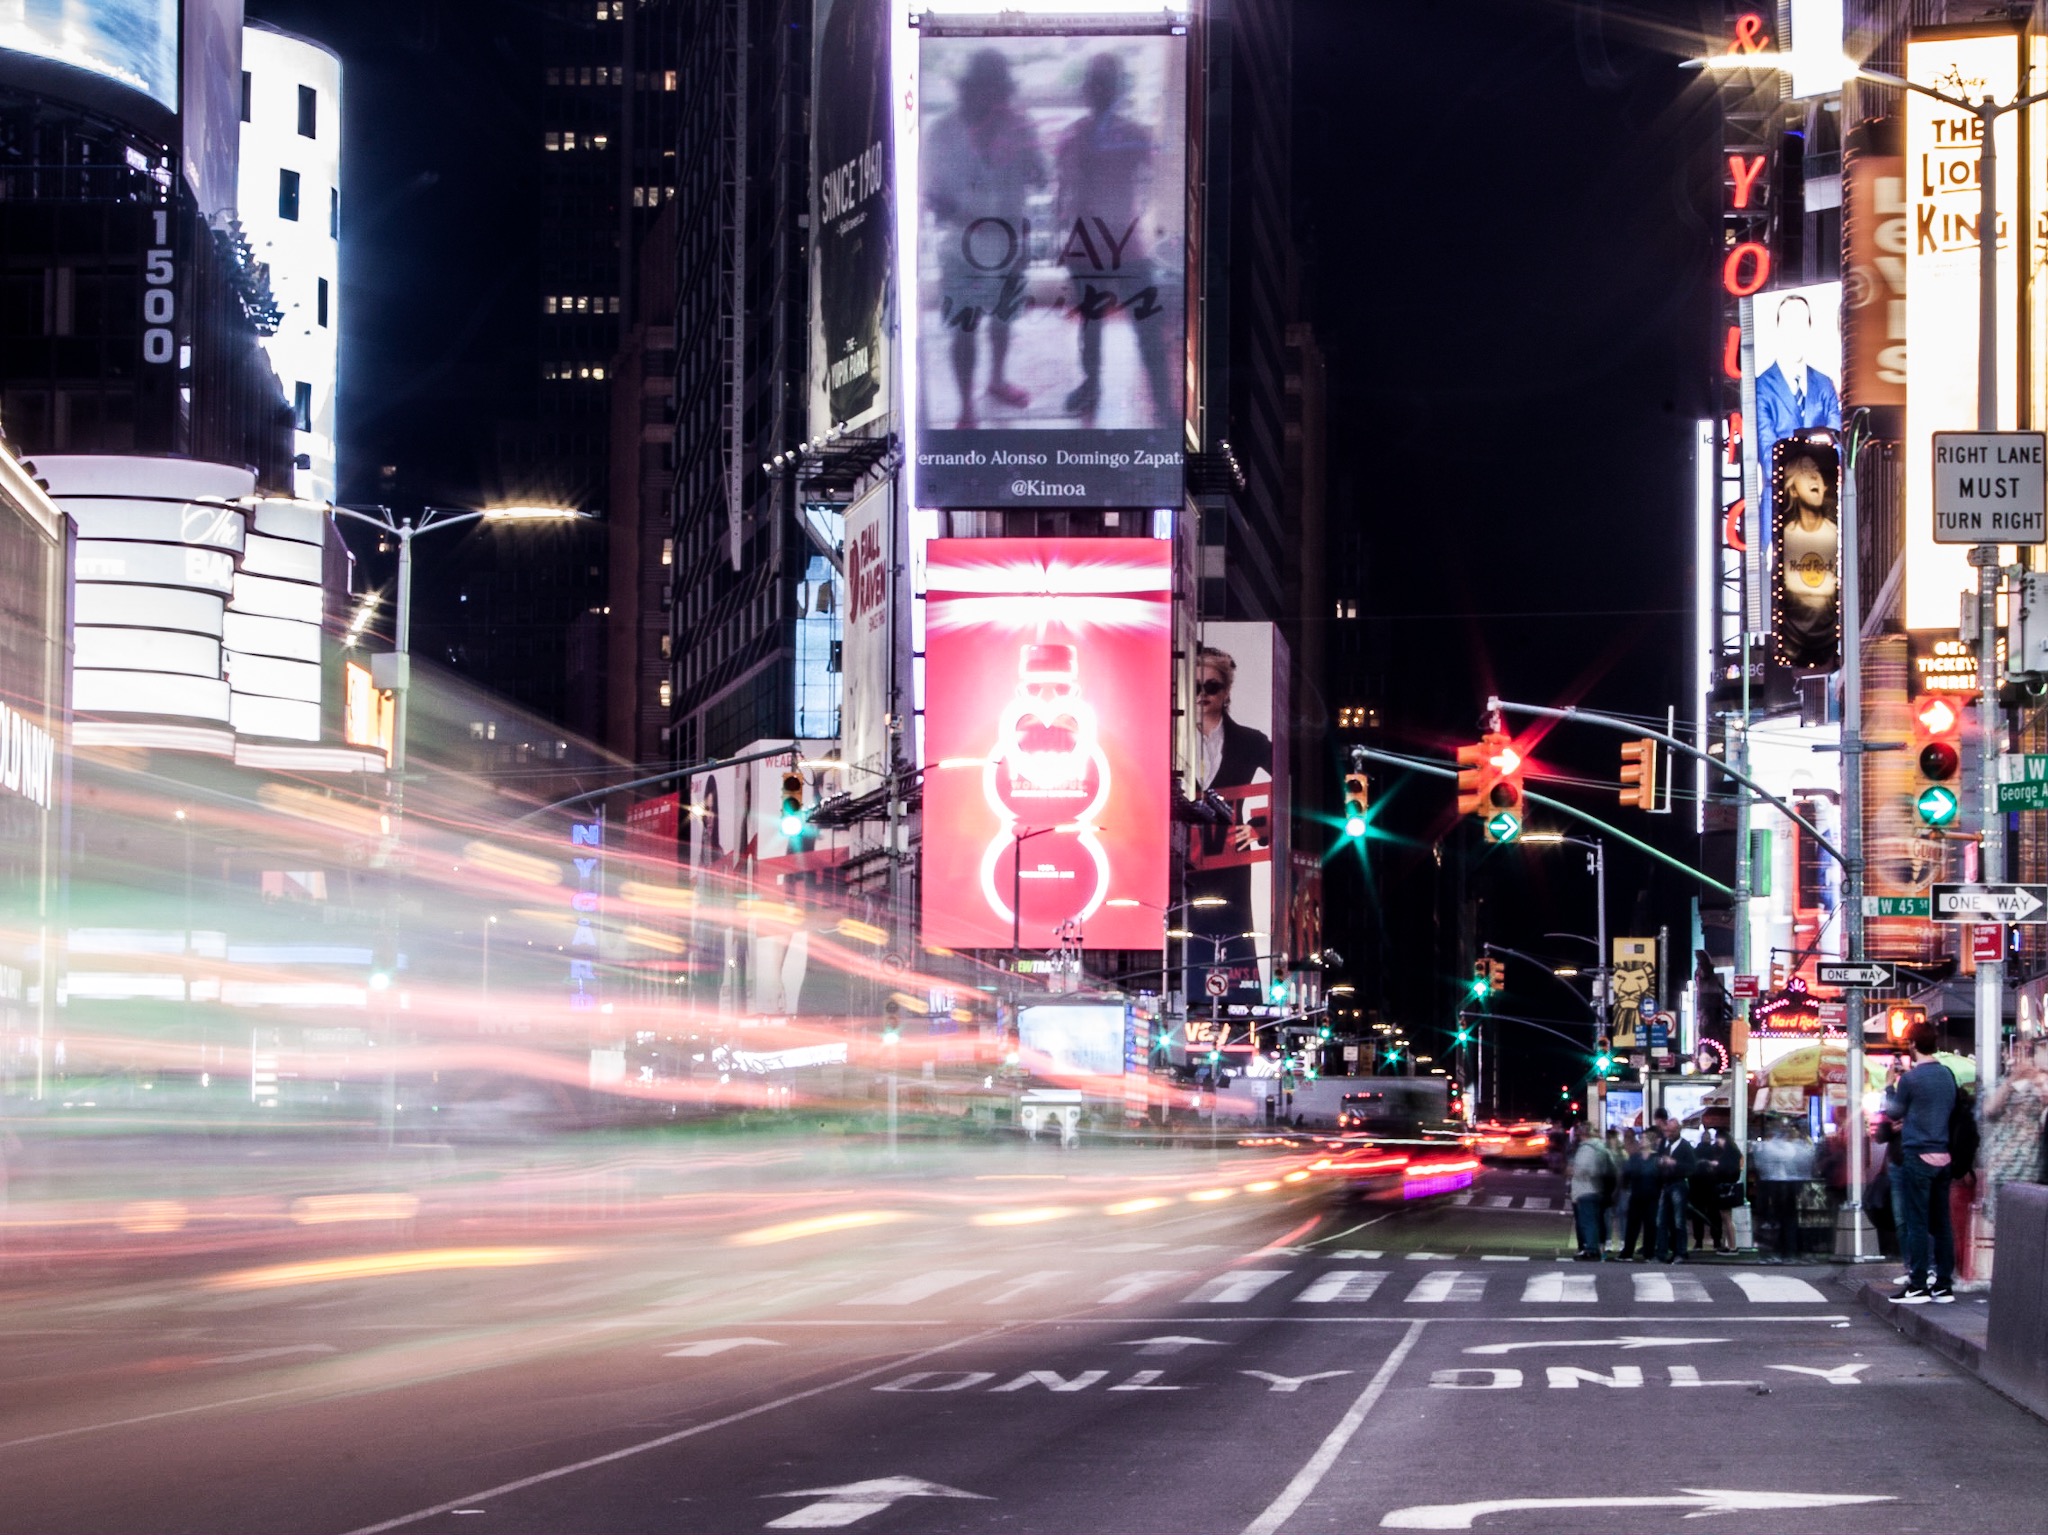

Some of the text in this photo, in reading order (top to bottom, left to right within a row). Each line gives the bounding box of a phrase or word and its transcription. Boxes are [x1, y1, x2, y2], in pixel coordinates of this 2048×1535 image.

[1932, 117, 1984, 143] THE
[822, 158, 856, 225] SINCE
[859, 140, 882, 202] 1960
[1922, 153, 1981, 197] LIO
[961, 216, 1140, 271] OLAY
[143, 210, 174, 364] 1500
[991, 450, 1047, 465] Alonso
[1056, 450, 1130, 468] Domingo
[1937, 446, 2042, 464] RIGHT LANE
[1011, 480, 1086, 496] @Kimoa
[1959, 477, 2020, 499] MUST
[1937, 512, 2043, 530] TURN RIGHT
[1790, 559, 1833, 574] Hard Rock
[2028, 758, 2046, 780] W
[2000, 785, 2038, 803] George
[1881, 900, 1893, 913] W
[1900, 899, 1914, 914] 45
[1948, 896, 2031, 910] ONE WAY
[1828, 970, 1883, 980] ONE WAY
[1770, 1013, 1799, 1028] Hard
[870, 1370, 1356, 1392] ONLY
[1428, 1364, 1872, 1389] ONLY
